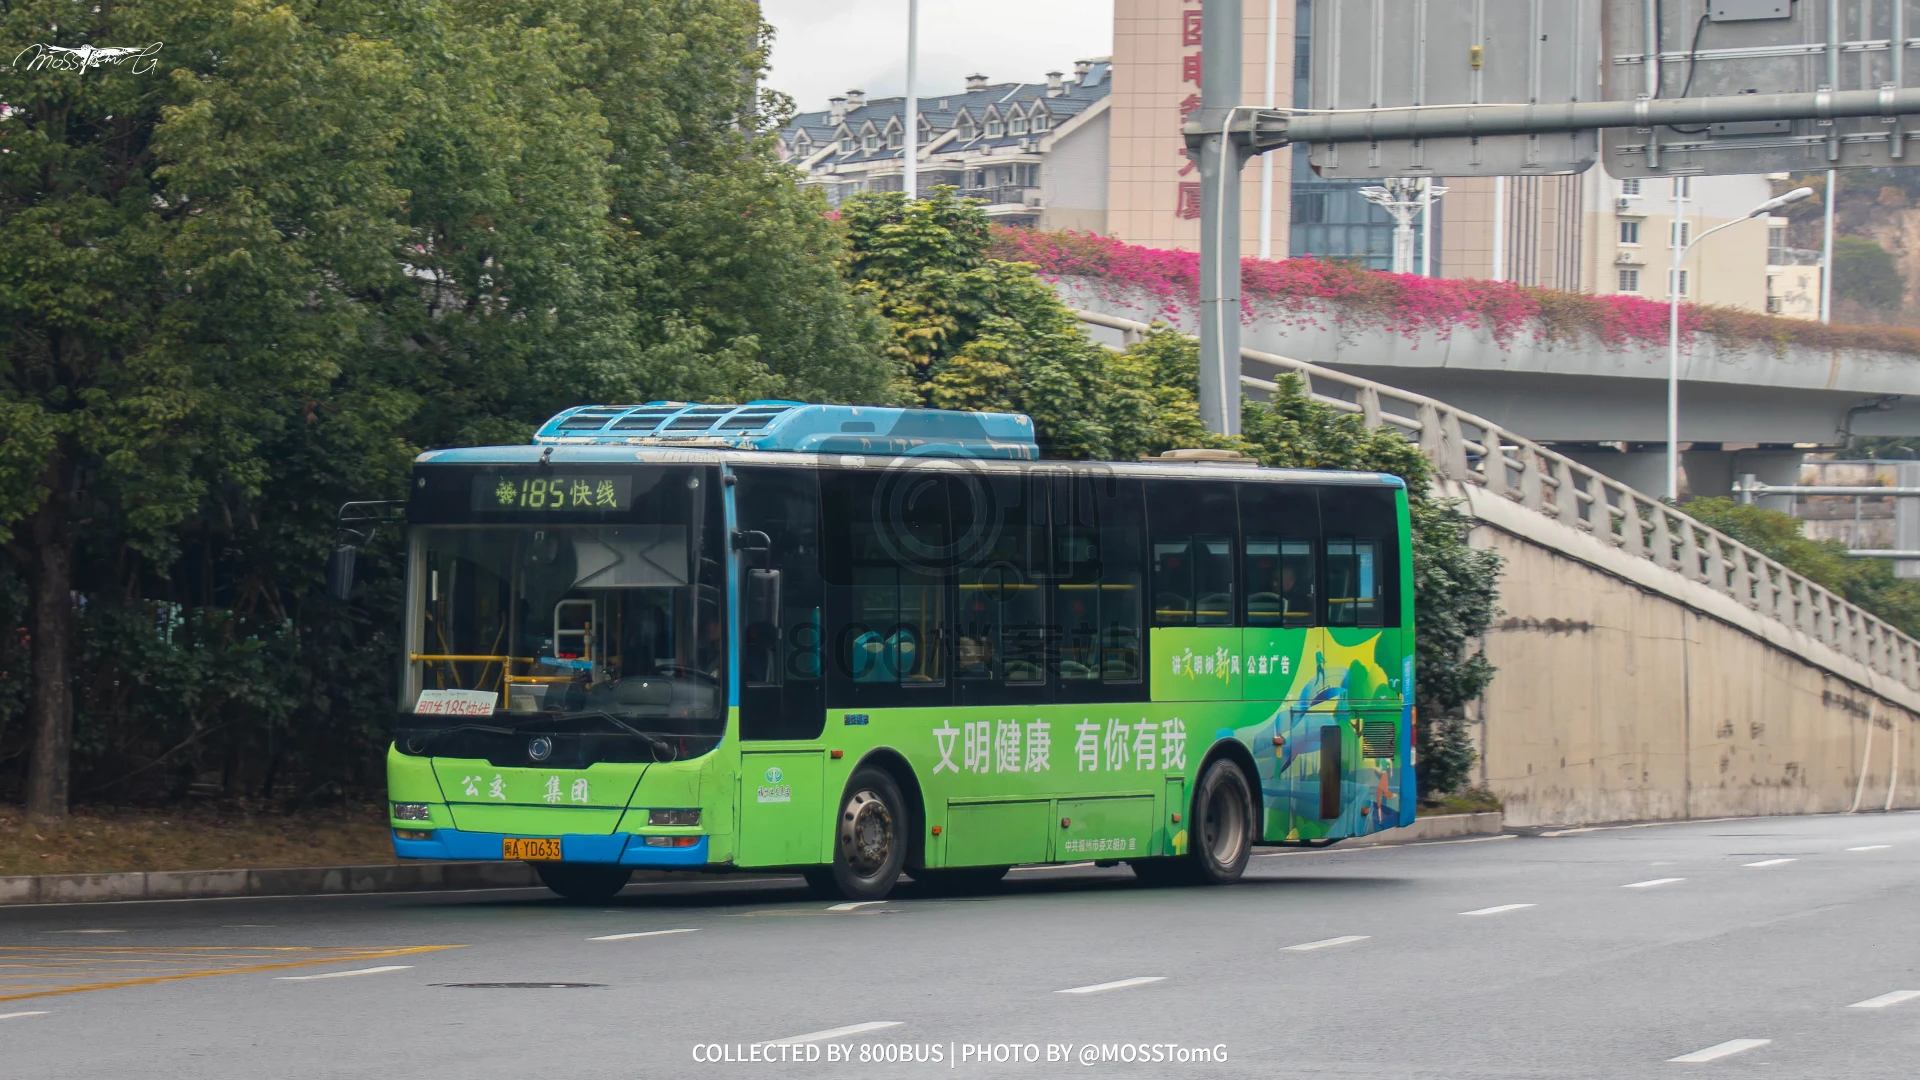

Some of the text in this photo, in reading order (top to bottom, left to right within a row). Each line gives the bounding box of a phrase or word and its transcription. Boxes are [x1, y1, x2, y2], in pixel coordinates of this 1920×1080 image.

[520, 478, 617, 508] 185快线
[1172, 646, 1290, 685] 讲文明树新风 公益广告
[932, 717, 1187, 775] 文明健康 有你有我
[461, 773, 589, 803] 公交 集团
